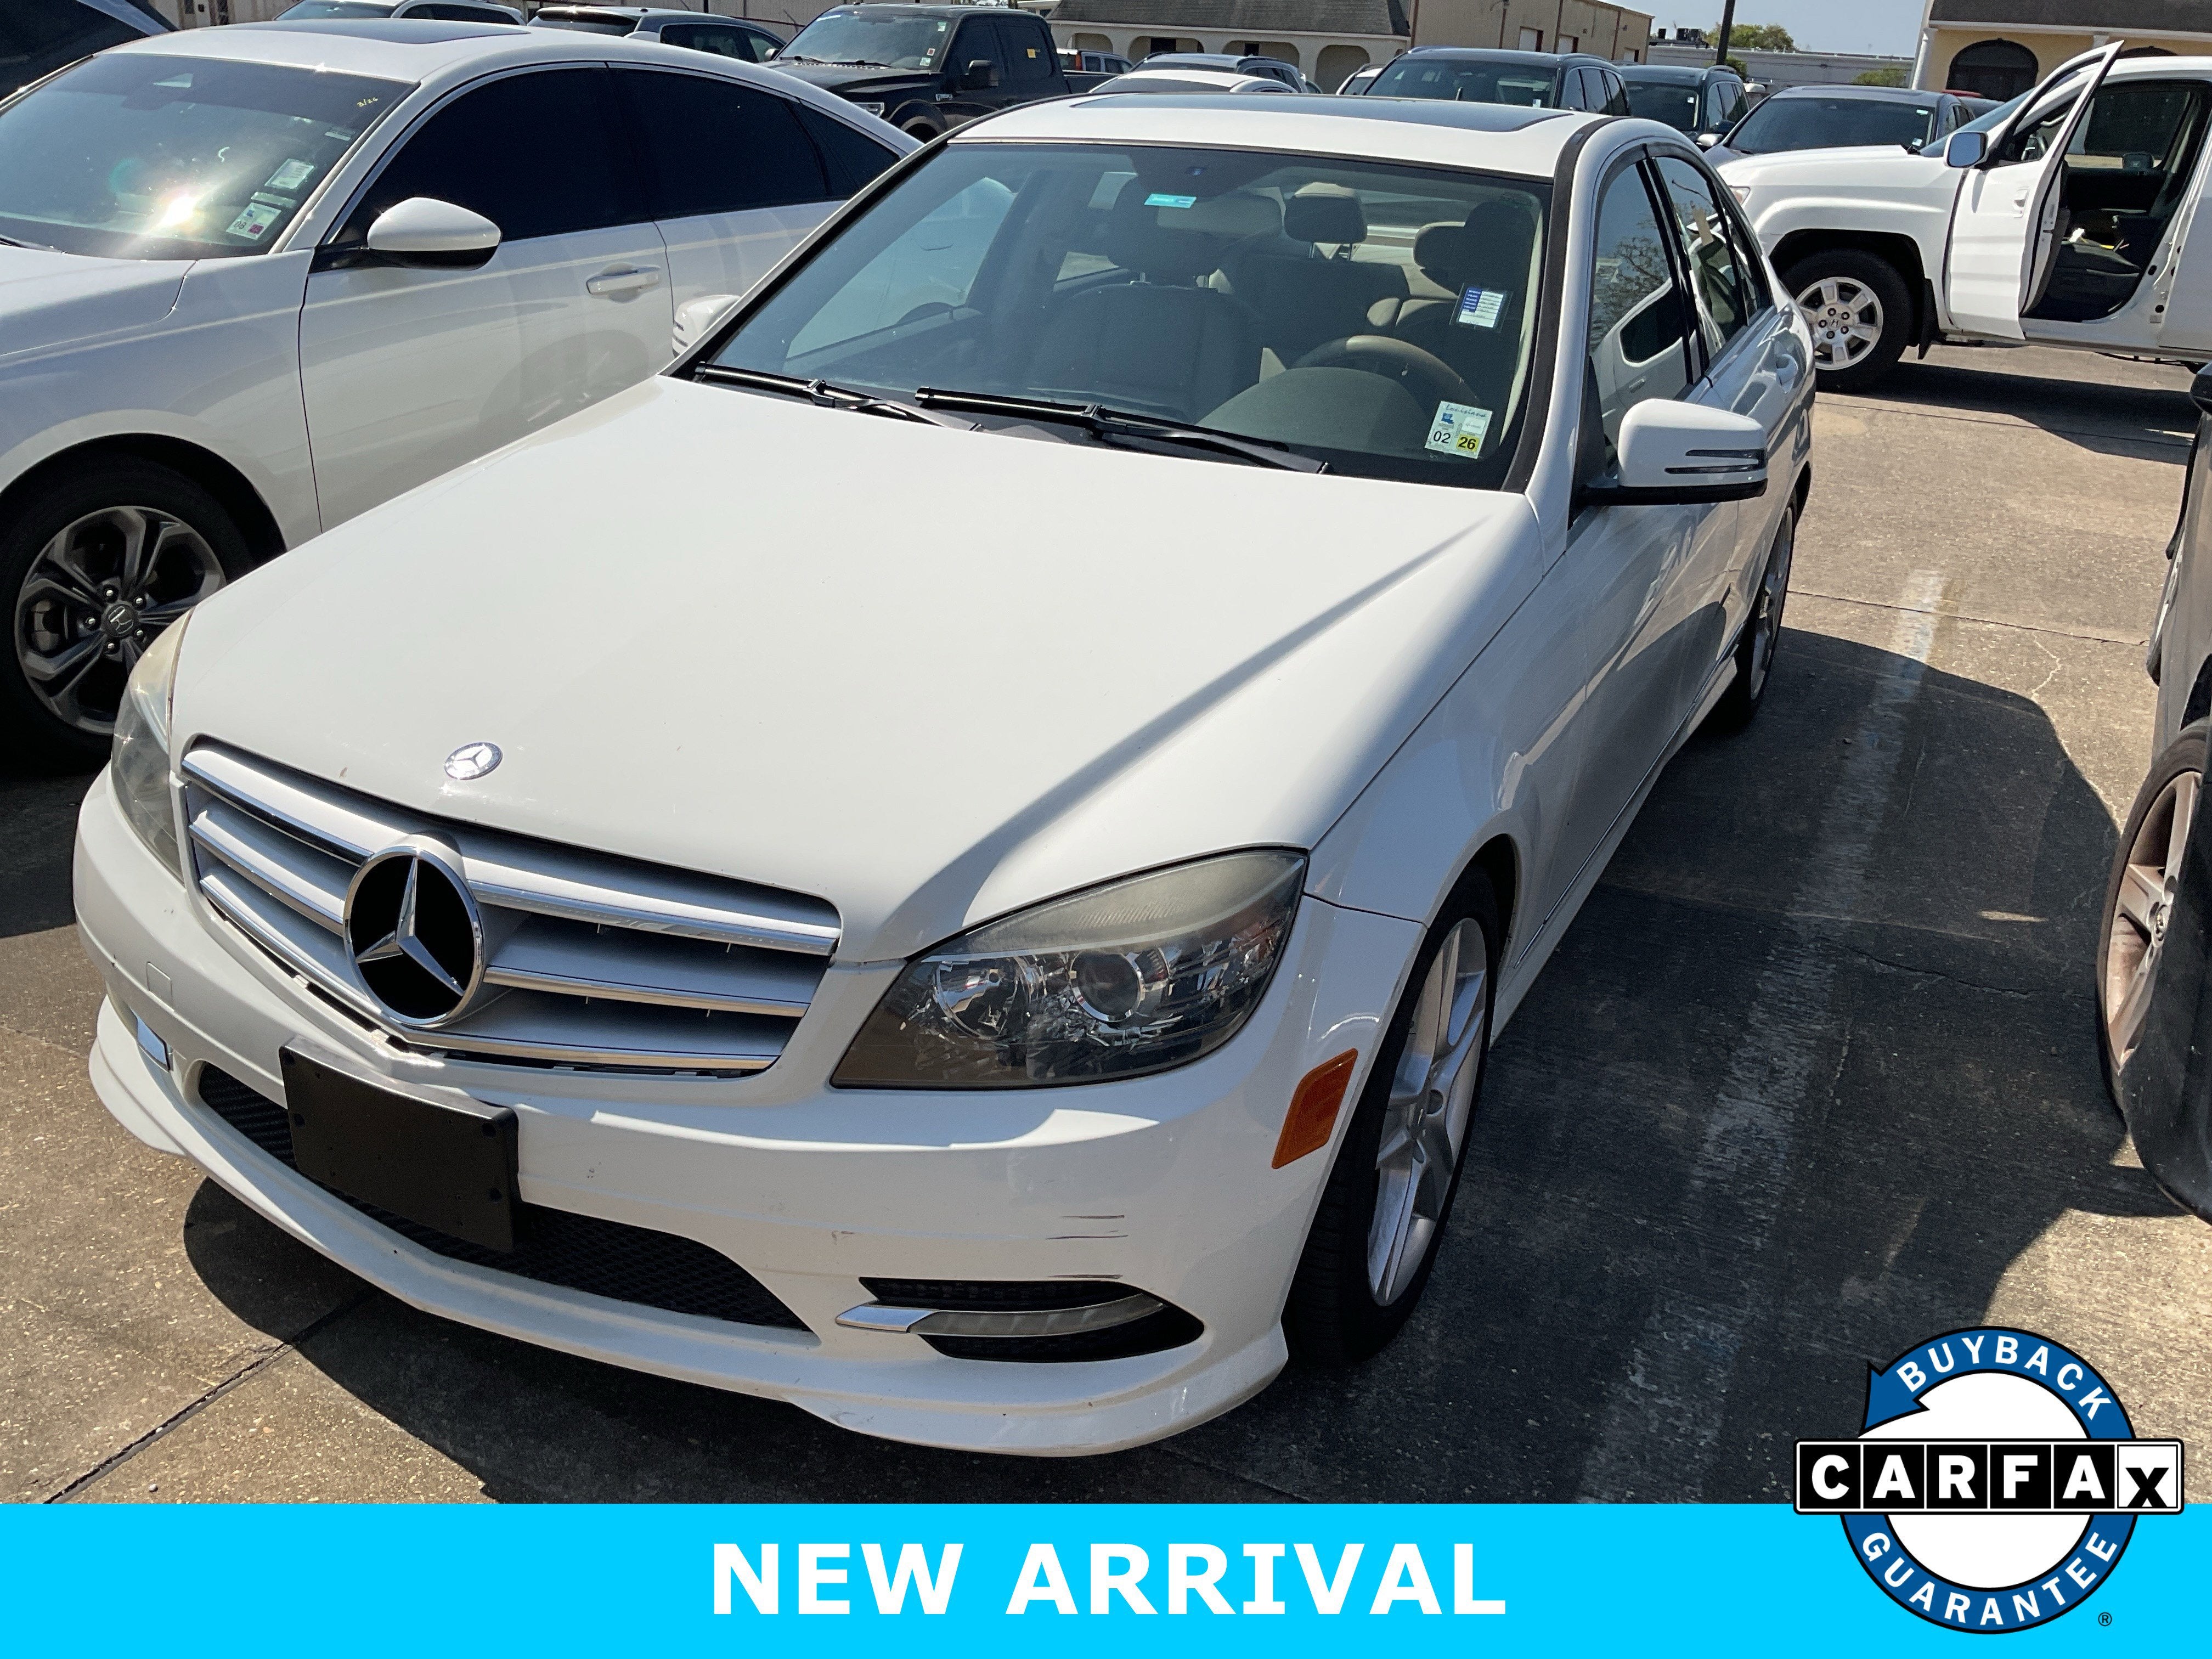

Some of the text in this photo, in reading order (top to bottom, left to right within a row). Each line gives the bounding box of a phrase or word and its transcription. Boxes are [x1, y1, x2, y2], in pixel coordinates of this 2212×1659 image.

[1446, 404, 1486, 417] Louisiana
[1434, 431, 1451, 444] 02
[1458, 437, 1476, 450] 26
